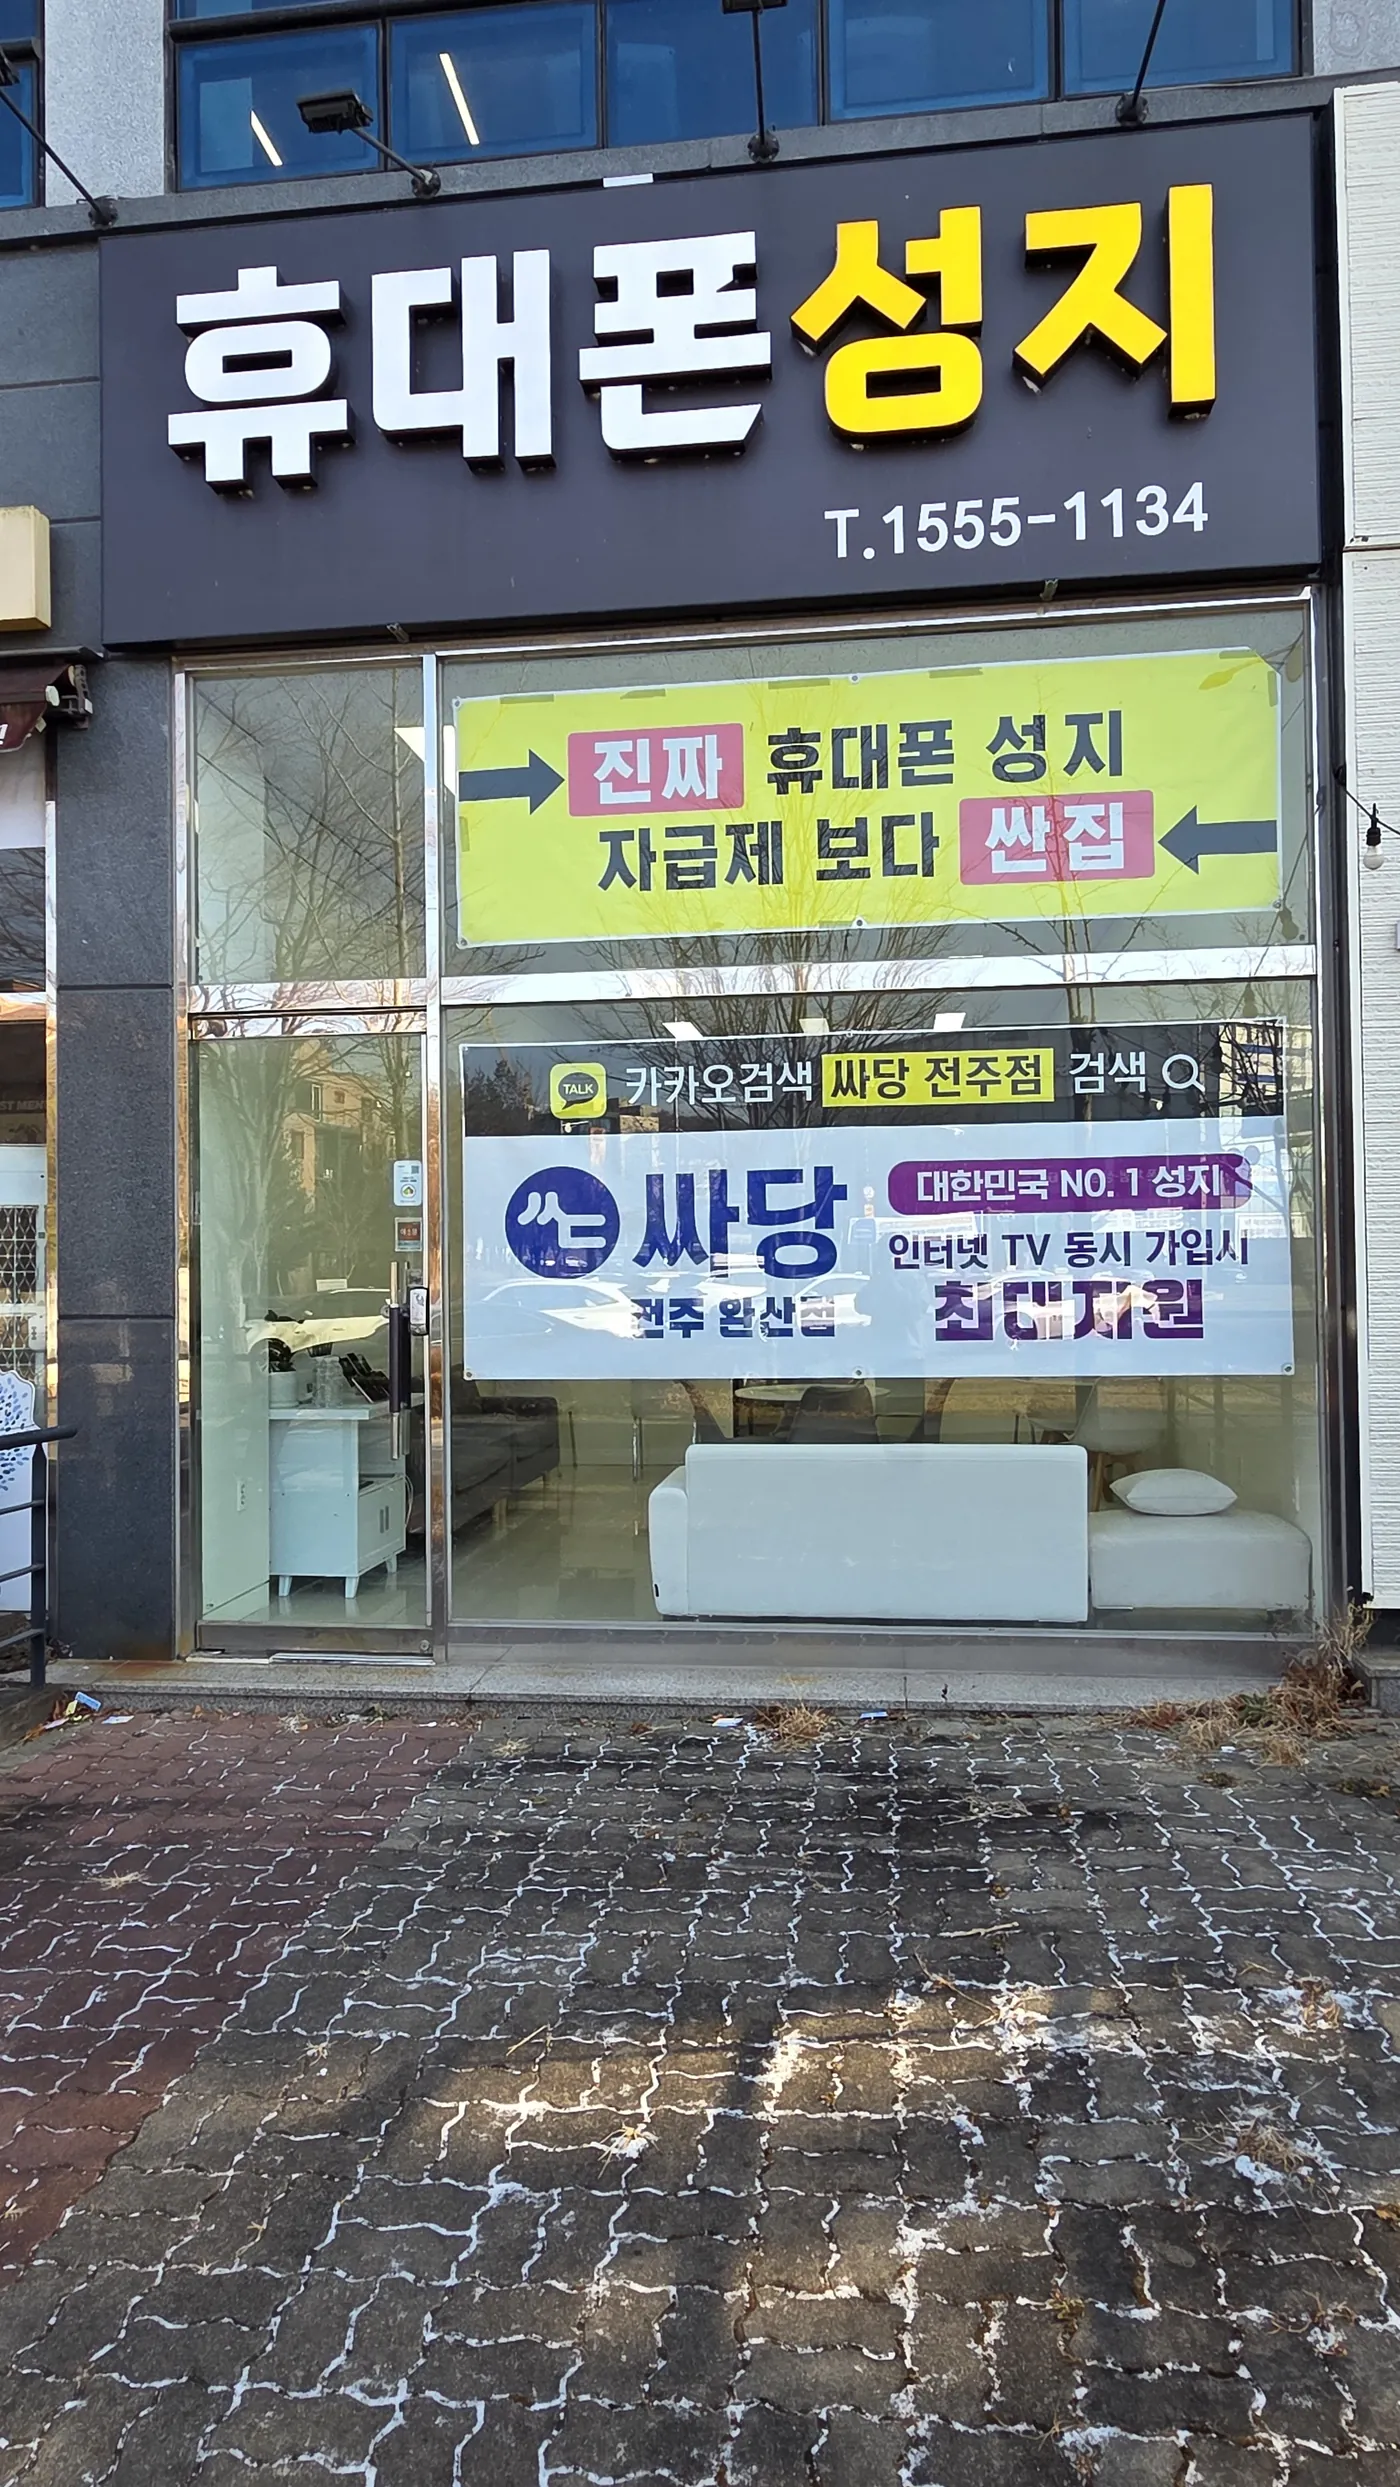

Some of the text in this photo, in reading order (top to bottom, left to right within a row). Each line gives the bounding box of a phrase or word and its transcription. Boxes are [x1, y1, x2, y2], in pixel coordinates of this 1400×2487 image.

[824, 481, 1209, 559] T.1555-1134
[592, 710, 1124, 804] 진짜 휴대폰 성지
[598, 802, 1126, 892] 자급제 보다 싼집
[562, 1083, 595, 1095] TALK
[625, 1050, 1147, 1107] 카카오검색 싸당 전주점 검색
[916, 1163, 1222, 1203] 대한민국 NO. 1 성지
[632, 1165, 849, 1279] 싸당
[888, 1228, 1250, 1271] 인터넷 TV 동시 가입시
[934, 1278, 1205, 1342] 최대지원
